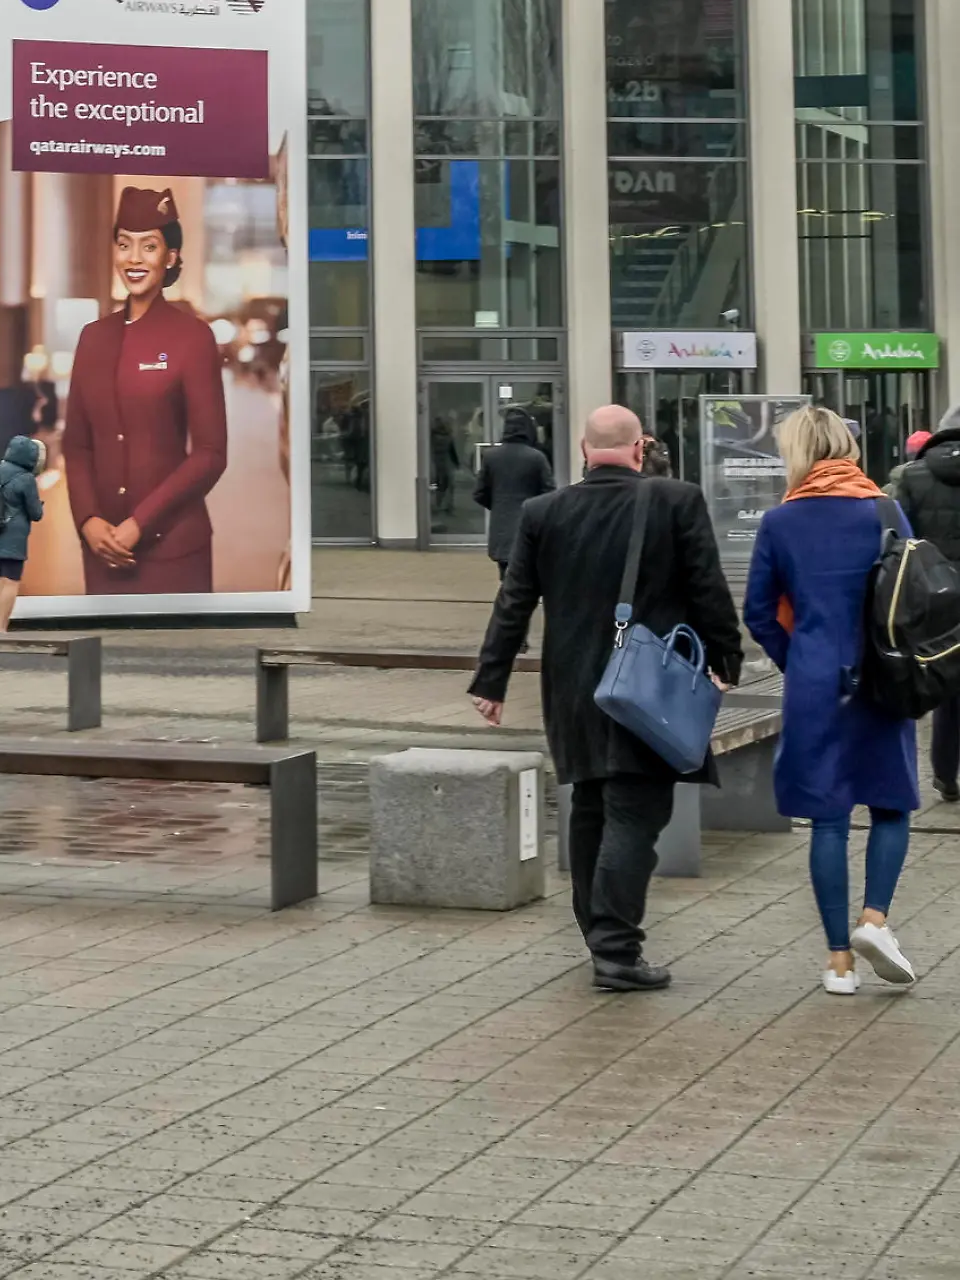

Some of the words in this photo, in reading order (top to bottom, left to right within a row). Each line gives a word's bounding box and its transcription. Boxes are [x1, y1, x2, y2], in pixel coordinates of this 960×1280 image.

[124, 0, 177, 14] AIRWAYS
[30, 62, 158, 91] Experience
[30, 94, 68, 119] the
[74, 100, 205, 127] exceptional
[30, 139, 167, 159] qatarairways.com
